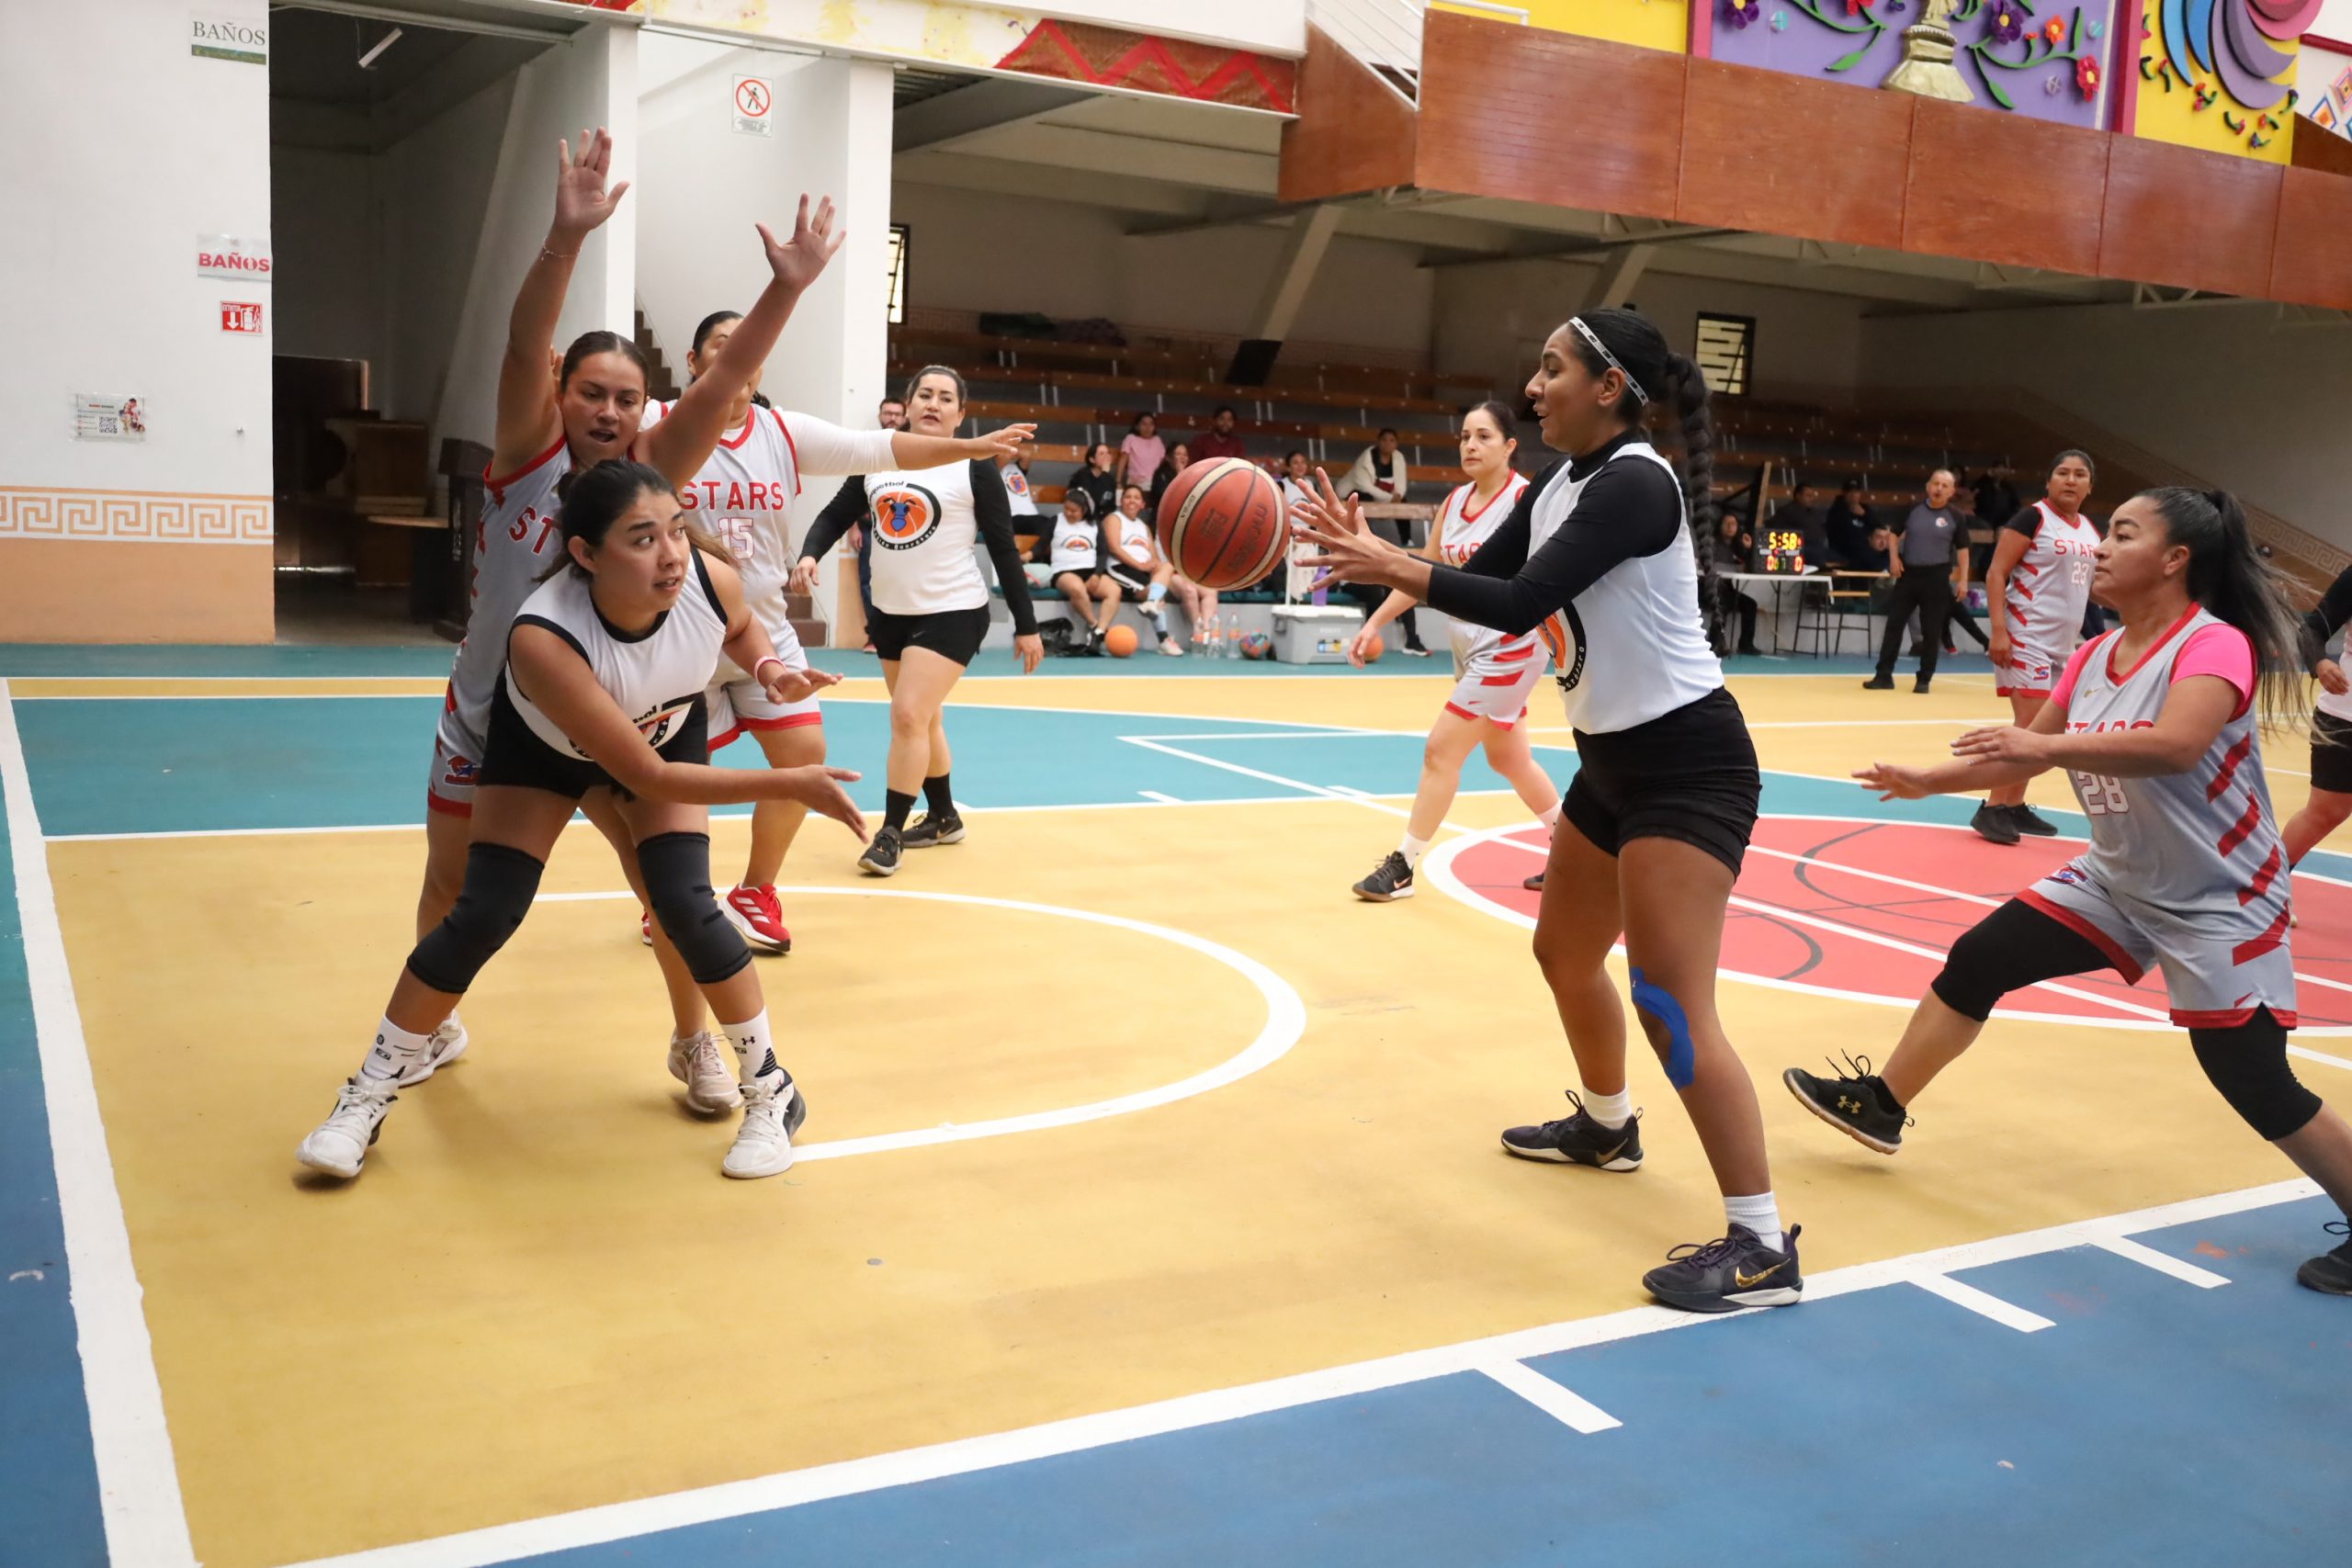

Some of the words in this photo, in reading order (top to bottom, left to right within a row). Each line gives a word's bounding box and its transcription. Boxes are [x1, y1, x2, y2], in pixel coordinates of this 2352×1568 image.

[193, 21, 266, 45] BAÑOS
[198, 252, 270, 272] BAÑOS
[683, 481, 784, 511] STARS
[718, 517, 754, 559] 15
[2054, 539, 2096, 558] STAR
[2077, 772, 2129, 815] 28
